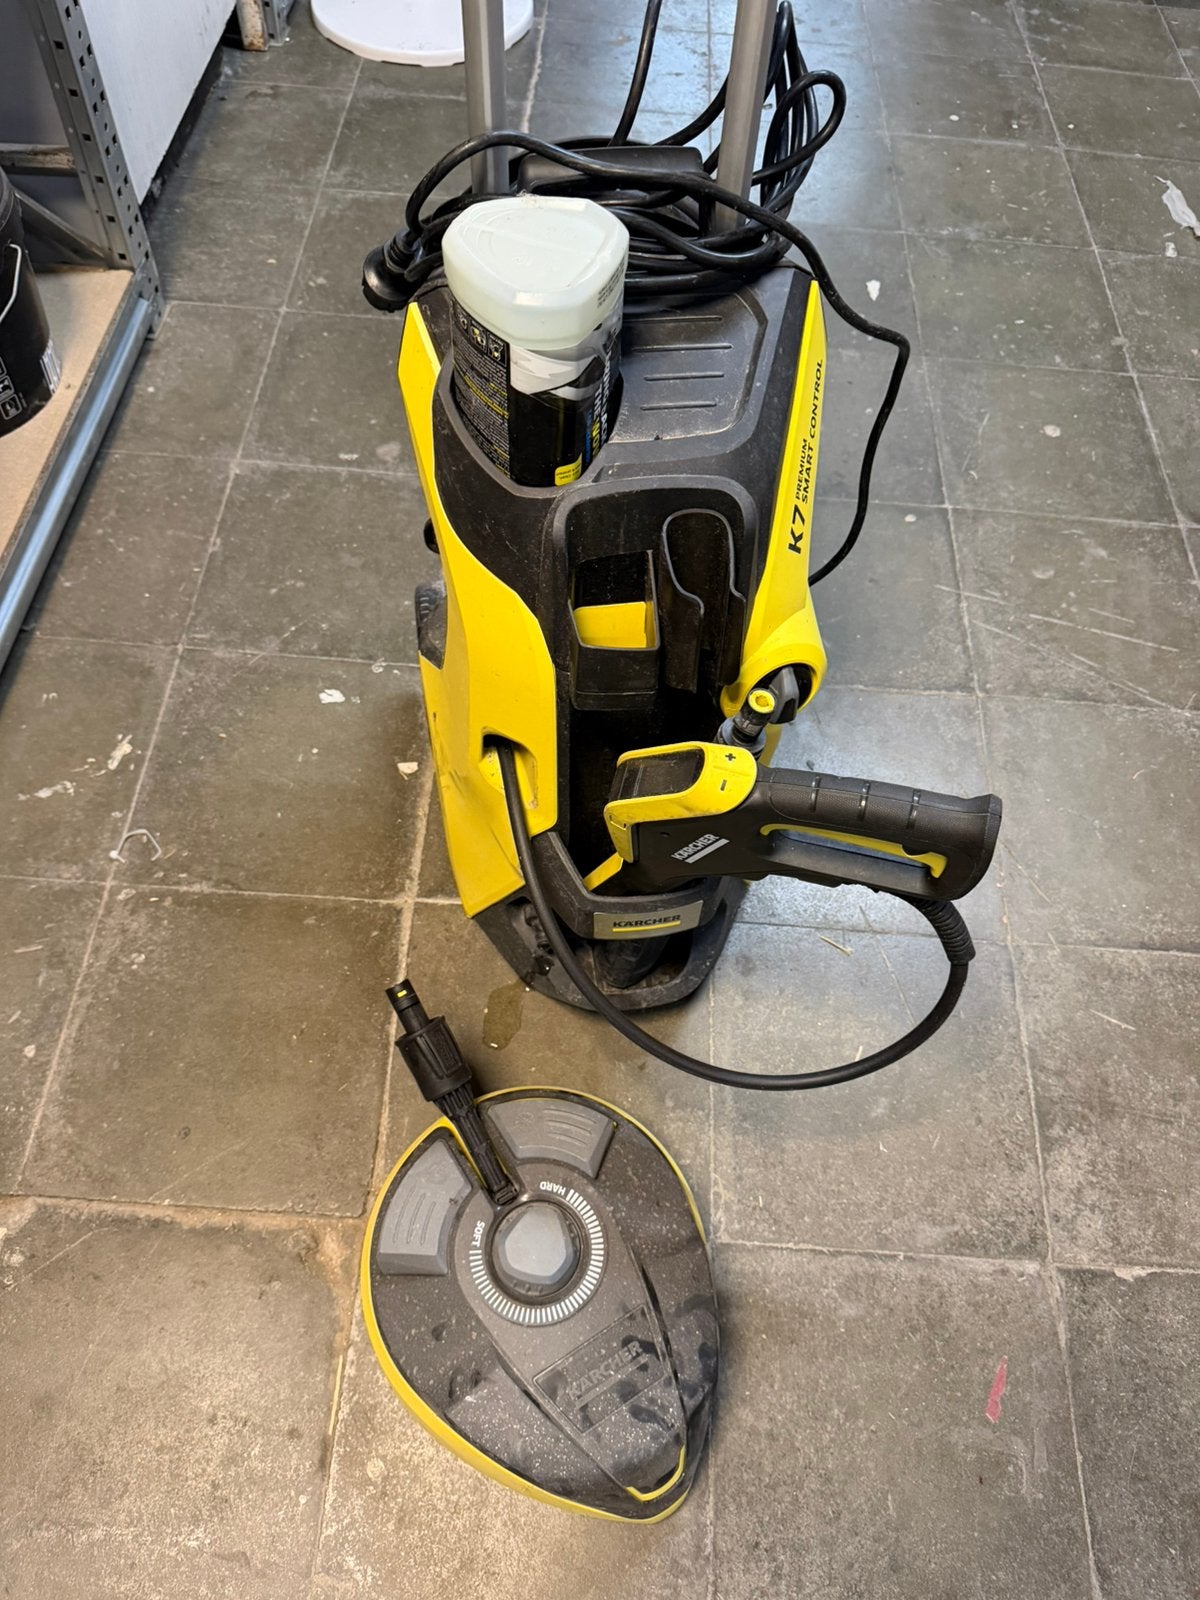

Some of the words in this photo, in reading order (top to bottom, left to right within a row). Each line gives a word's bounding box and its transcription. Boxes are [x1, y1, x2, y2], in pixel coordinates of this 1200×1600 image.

[801, 443, 814, 504] SMART
[809, 359, 823, 439] CONTROL
[795, 438, 808, 500] PREMIUM
[788, 504, 805, 554] K7
[540, 1180, 566, 1196] HARD
[471, 1220, 485, 1248] SOFT
